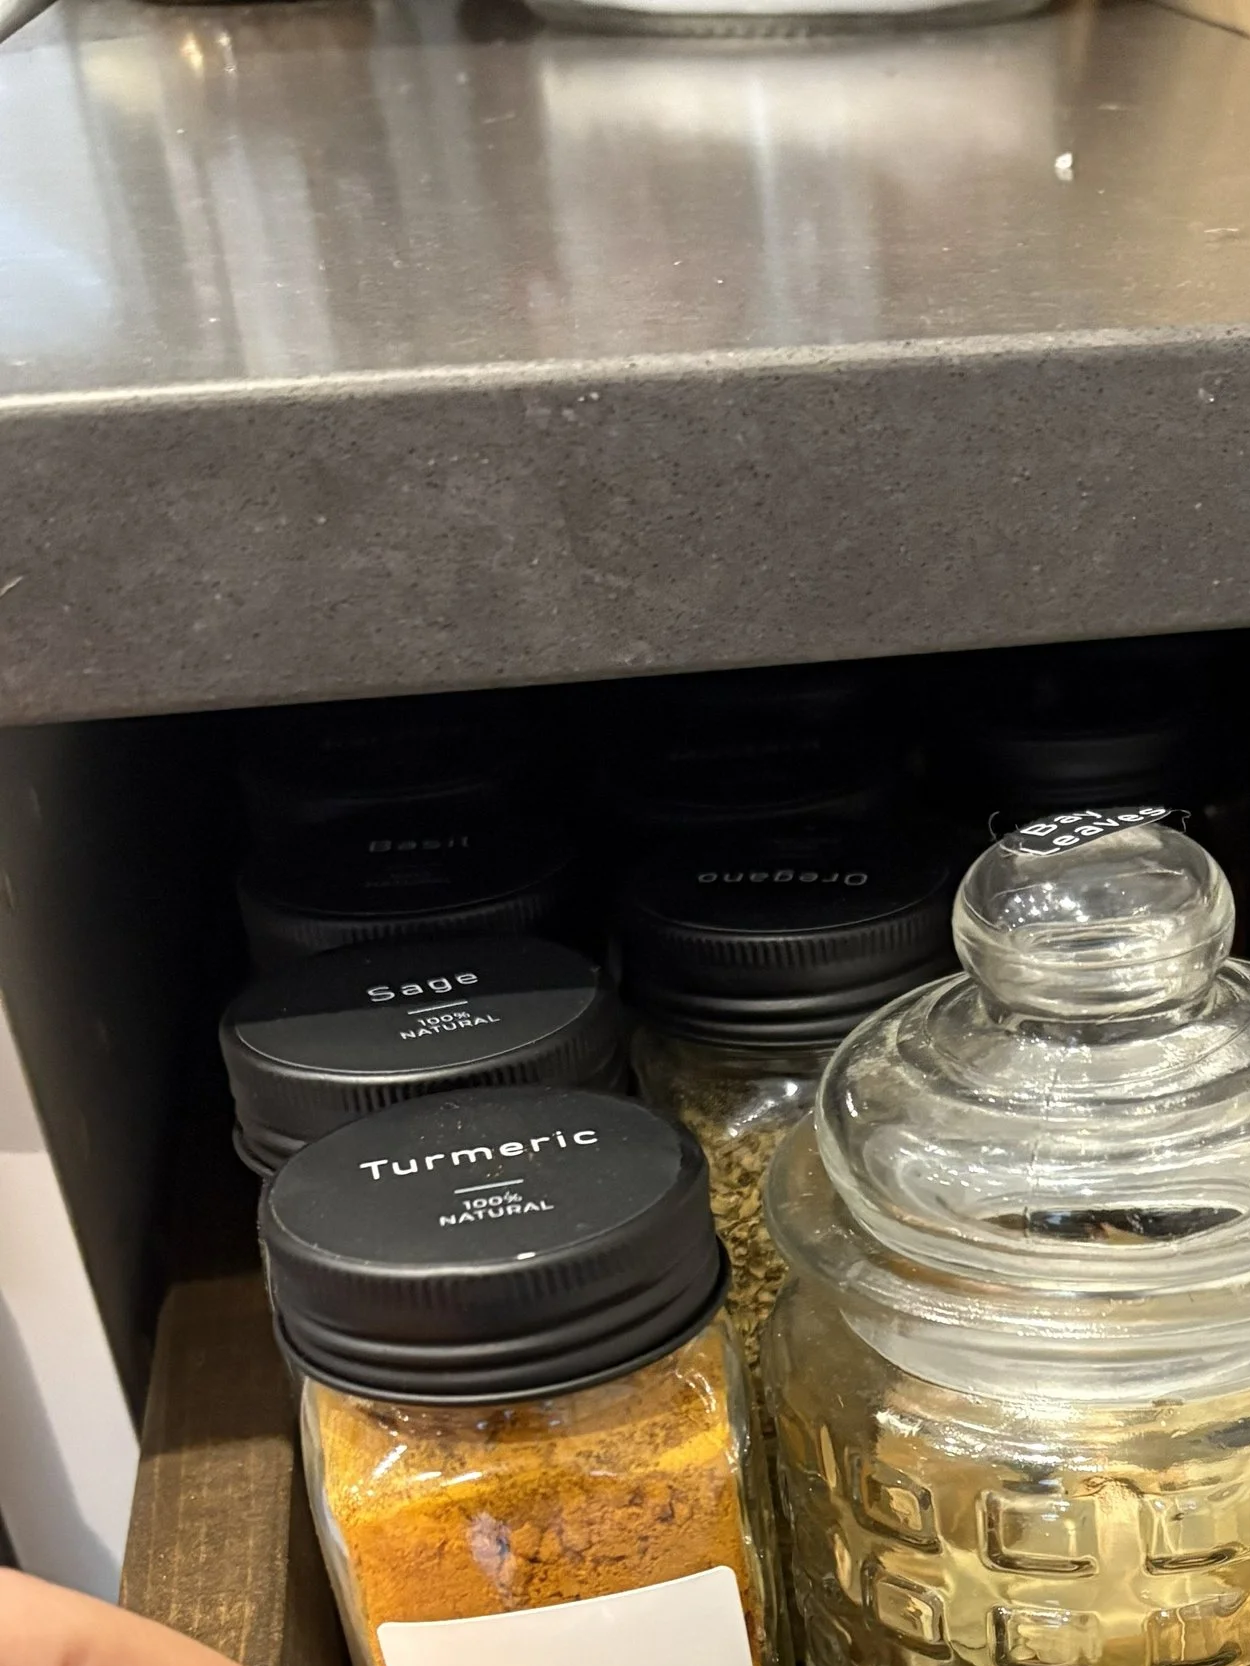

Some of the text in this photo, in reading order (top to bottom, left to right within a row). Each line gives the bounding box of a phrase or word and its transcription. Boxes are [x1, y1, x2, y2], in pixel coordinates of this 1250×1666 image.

[1020, 809, 1102, 837] Bay
[1020, 808, 1166, 855] Leaves
[697, 869, 869, 887] Oregano
[366, 972, 479, 1003] Sage
[400, 1013, 502, 1040] NATURAL
[416, 1010, 471, 1027] 100%
[359, 1129, 599, 1181] Turmeric
[438, 1200, 555, 1227] NATURAL
[462, 1190, 523, 1211] 100%
